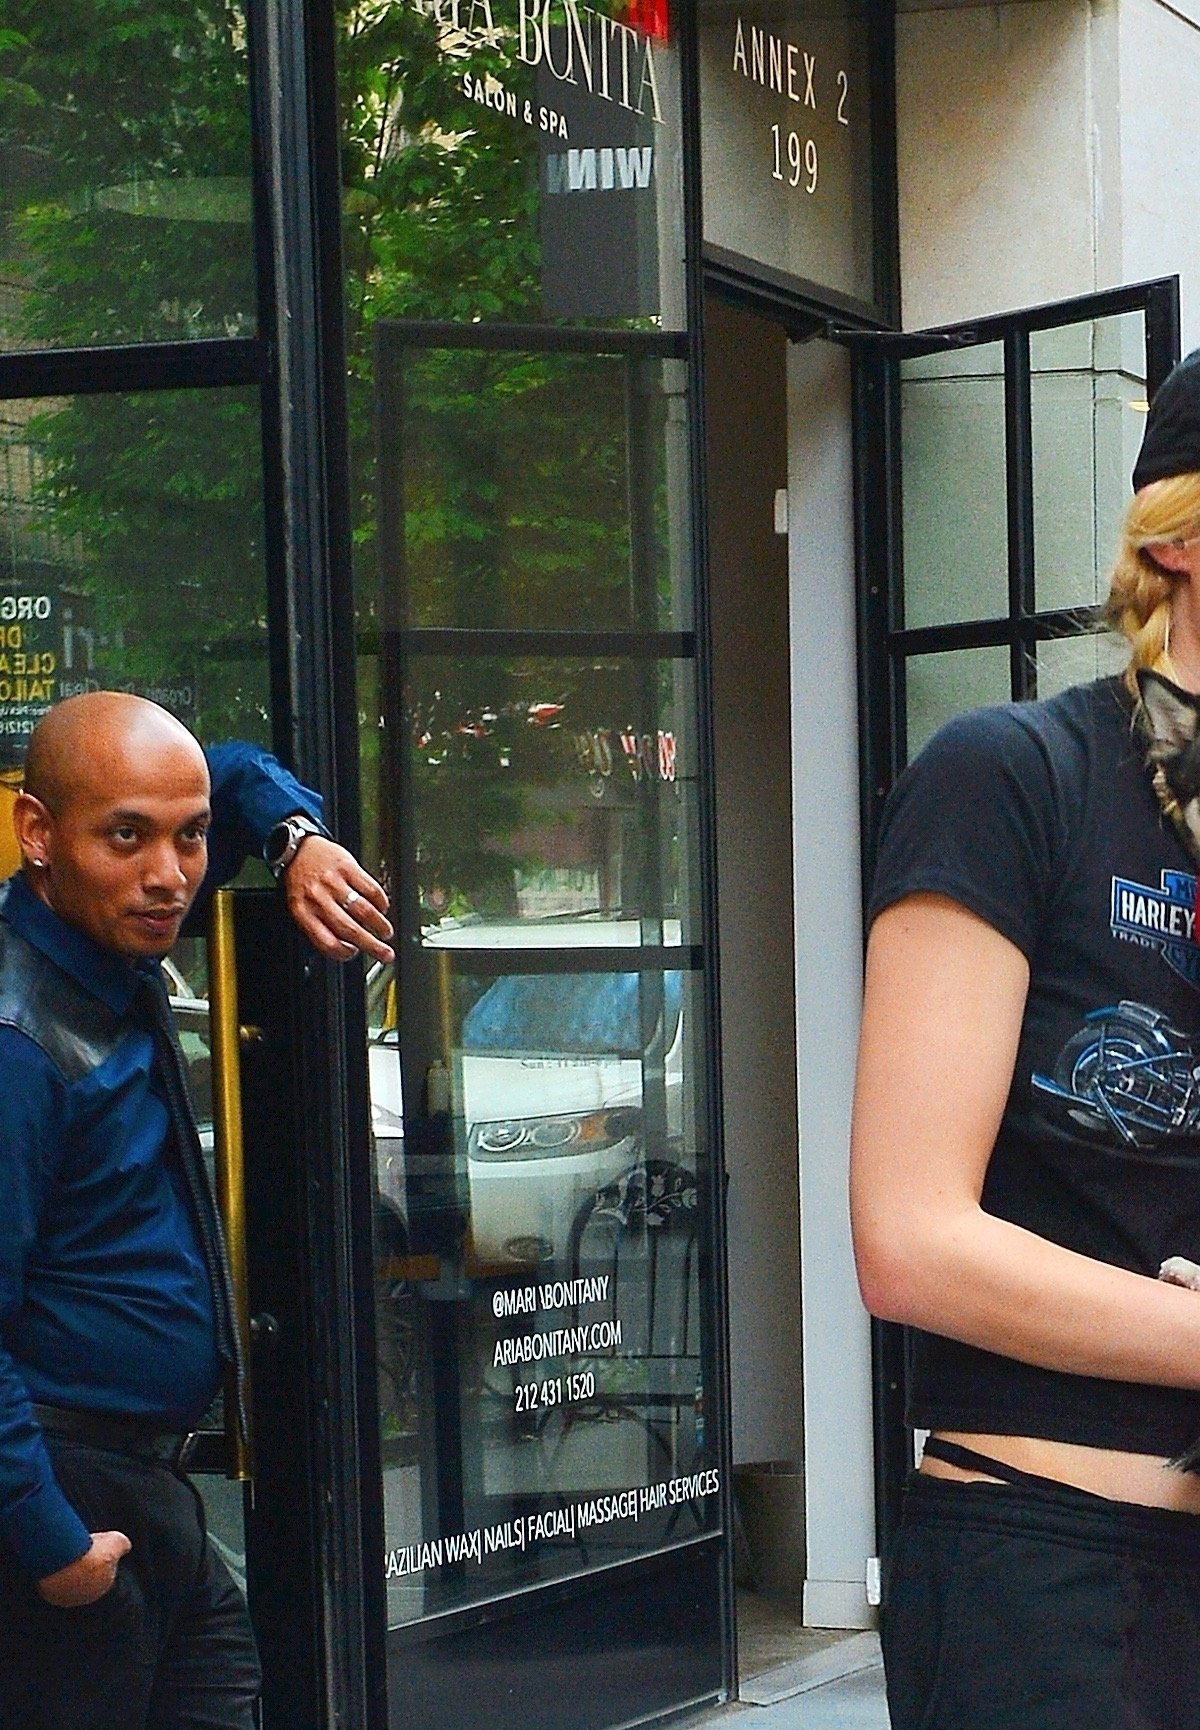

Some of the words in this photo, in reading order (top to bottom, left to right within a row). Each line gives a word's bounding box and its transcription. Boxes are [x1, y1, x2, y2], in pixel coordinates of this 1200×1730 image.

[733, 17, 816, 110] ANNEX
[837, 70, 849, 125] 2
[463, 72, 517, 118] SALON
[523, 100, 533, 125] &
[539, 106, 569, 140] SPA
[771, 124, 818, 194] 199
[1121, 889, 1196, 939] HARLEY
[493, 1320, 622, 1367] ARIABONITANY.COM
[515, 1382, 539, 1412] 212
[540, 1378, 562, 1407] 431
[566, 1371, 595, 1401] 1520
[639, 1482, 667, 1513] HAIR
[669, 1468, 720, 1505] SERVICES
